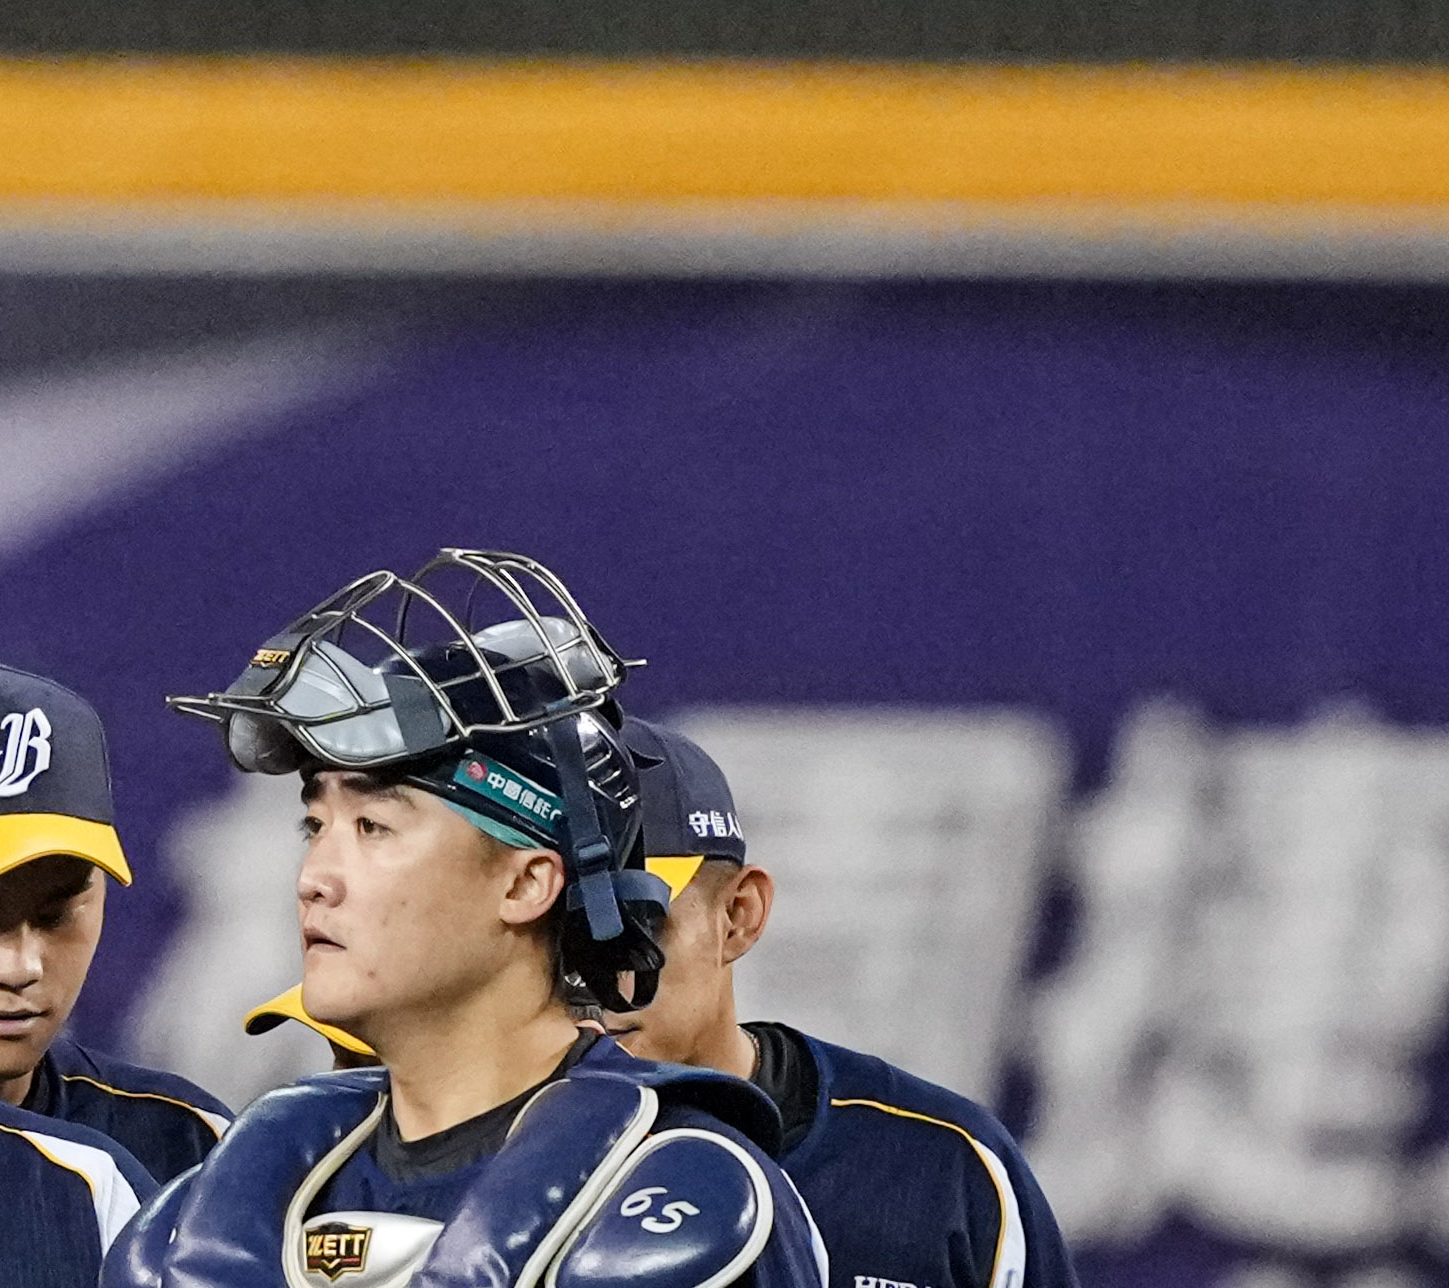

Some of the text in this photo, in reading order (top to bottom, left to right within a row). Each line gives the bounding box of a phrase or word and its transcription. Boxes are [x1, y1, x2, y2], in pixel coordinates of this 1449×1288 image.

[689, 810, 744, 841] 守信人
[620, 1186, 700, 1233] 65
[307, 1233, 365, 1256] ZETT
